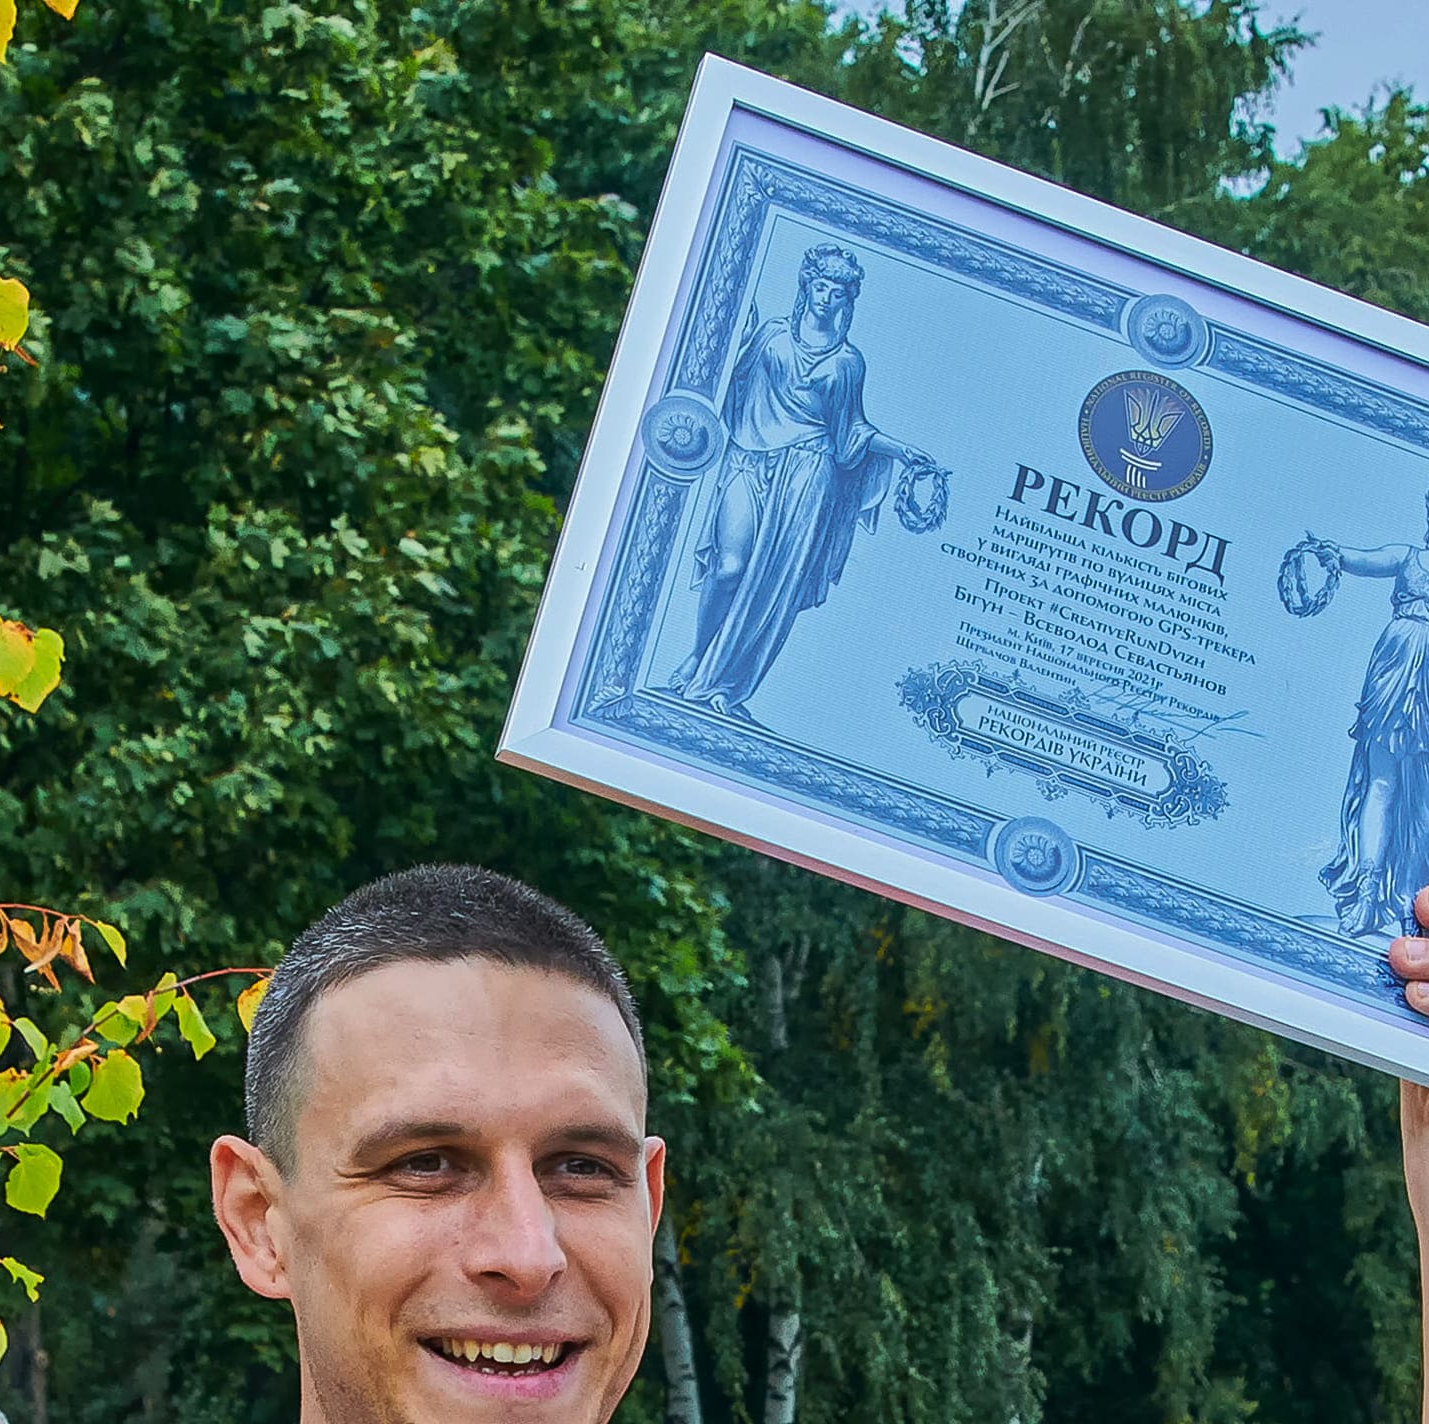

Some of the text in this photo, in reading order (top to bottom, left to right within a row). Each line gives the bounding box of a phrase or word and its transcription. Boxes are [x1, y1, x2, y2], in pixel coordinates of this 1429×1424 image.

[1007, 462, 1232, 588] РЕКОРД
[985, 577, 1046, 611] Проект
[954, 585, 1004, 615] Бігун
[1023, 610, 1109, 655] Всеволод
[1114, 644, 1227, 696] Севастьянов
[1061, 644, 1075, 657] 17
[978, 716, 1148, 787] РЕКОРДІВ УКРАЇНИ
[987, 704, 1098, 752] НАЦІОНАЛЬНИЙ
[1099, 745, 1146, 769] РЕЄСТР
